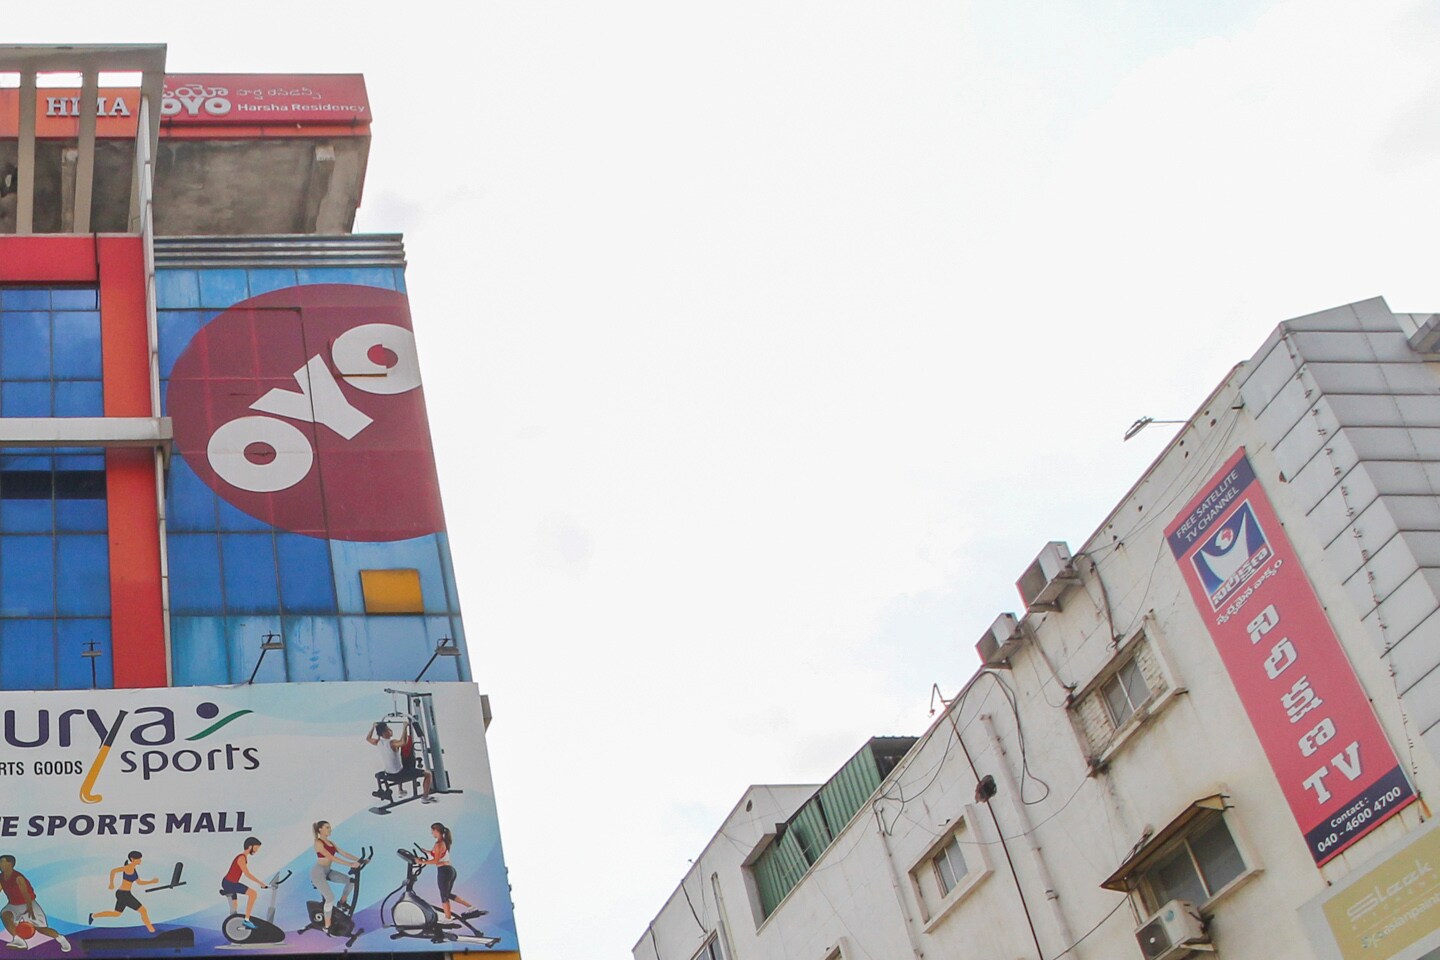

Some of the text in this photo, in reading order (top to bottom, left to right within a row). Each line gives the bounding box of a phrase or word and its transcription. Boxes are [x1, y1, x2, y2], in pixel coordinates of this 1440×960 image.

[160, 98, 232, 115] OYO
[238, 103, 365, 113] Harsha Residency
[207, 323, 422, 492] OYO
[1176, 469, 1239, 538] FREE SATELLITE
[1185, 487, 1239, 542] TV CHANNEL
[34, 761, 83, 775] GOODS
[120, 744, 260, 780] sports
[1303, 741, 1361, 804] TV
[27, 813, 156, 837] SPORTS
[165, 811, 252, 834] MALL
[1317, 833, 1338, 853] 040
[1345, 808, 1372, 833] 4600
[1373, 786, 1402, 812] 4700
[1330, 799, 1364, 828] Contact
